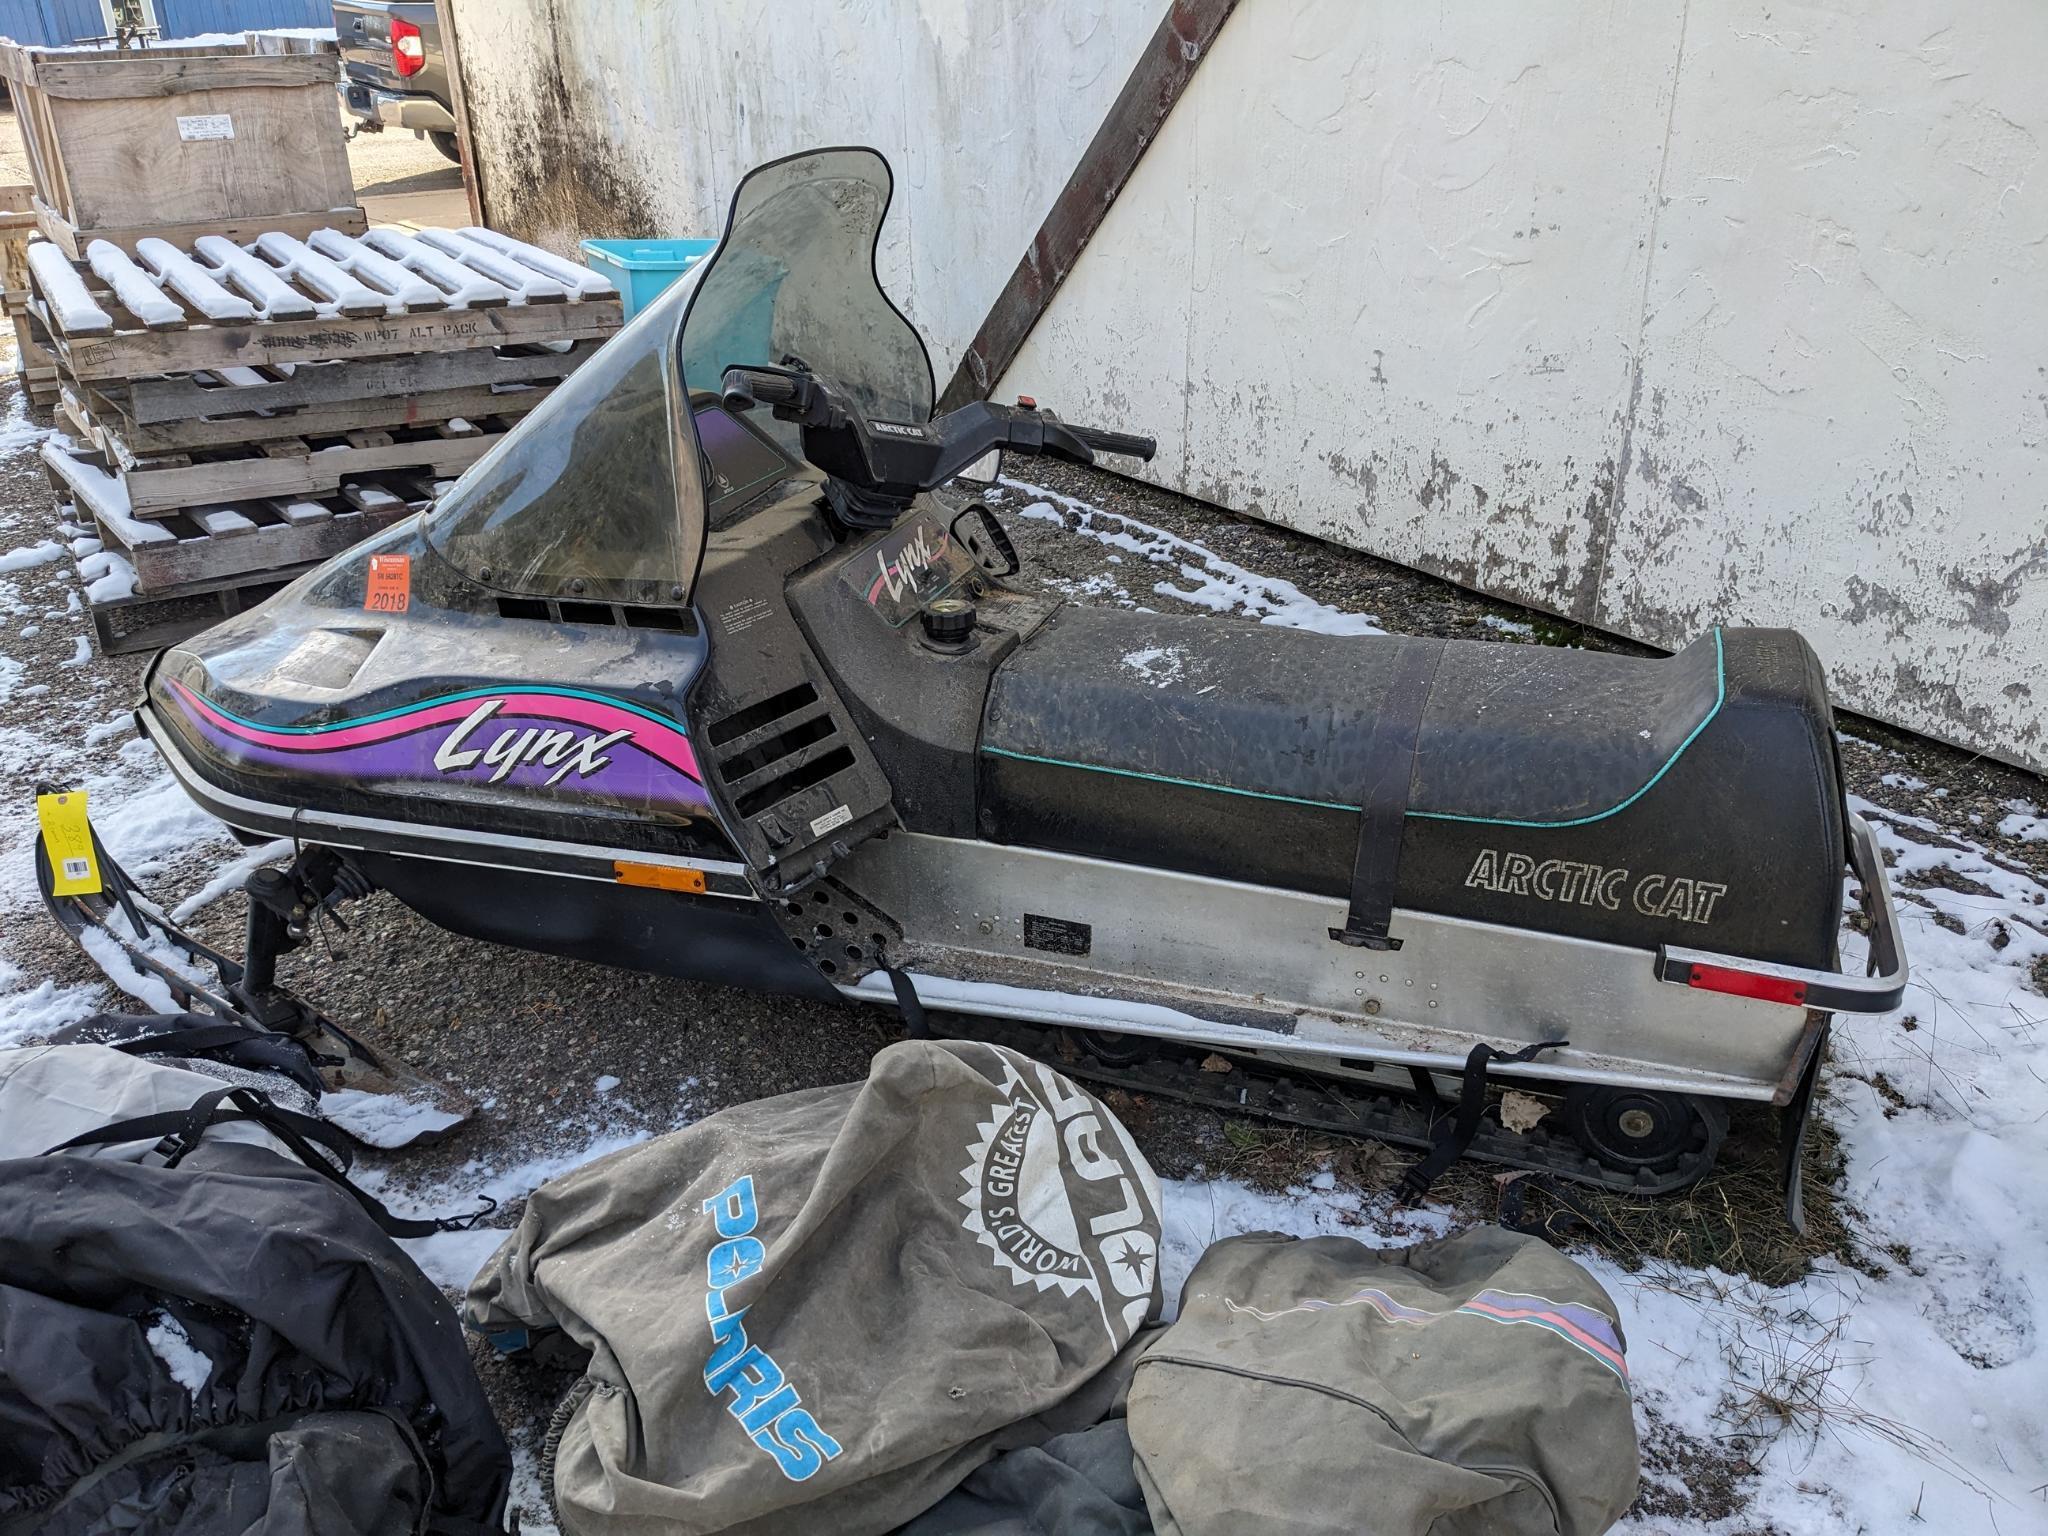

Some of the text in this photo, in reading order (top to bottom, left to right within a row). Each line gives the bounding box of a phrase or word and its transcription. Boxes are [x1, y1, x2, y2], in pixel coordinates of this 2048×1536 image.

[409, 326, 434, 338] ALT
[443, 323, 477, 336] PACK
[875, 423, 907, 435] ARCTIC
[371, 592, 406, 610] 2018
[876, 525, 932, 602] Lynx
[434, 699, 636, 786] Lynx
[1464, 848, 1727, 924] ARCTIC CAT
[987, 1095, 1080, 1273] WORLD'S GREATEST
